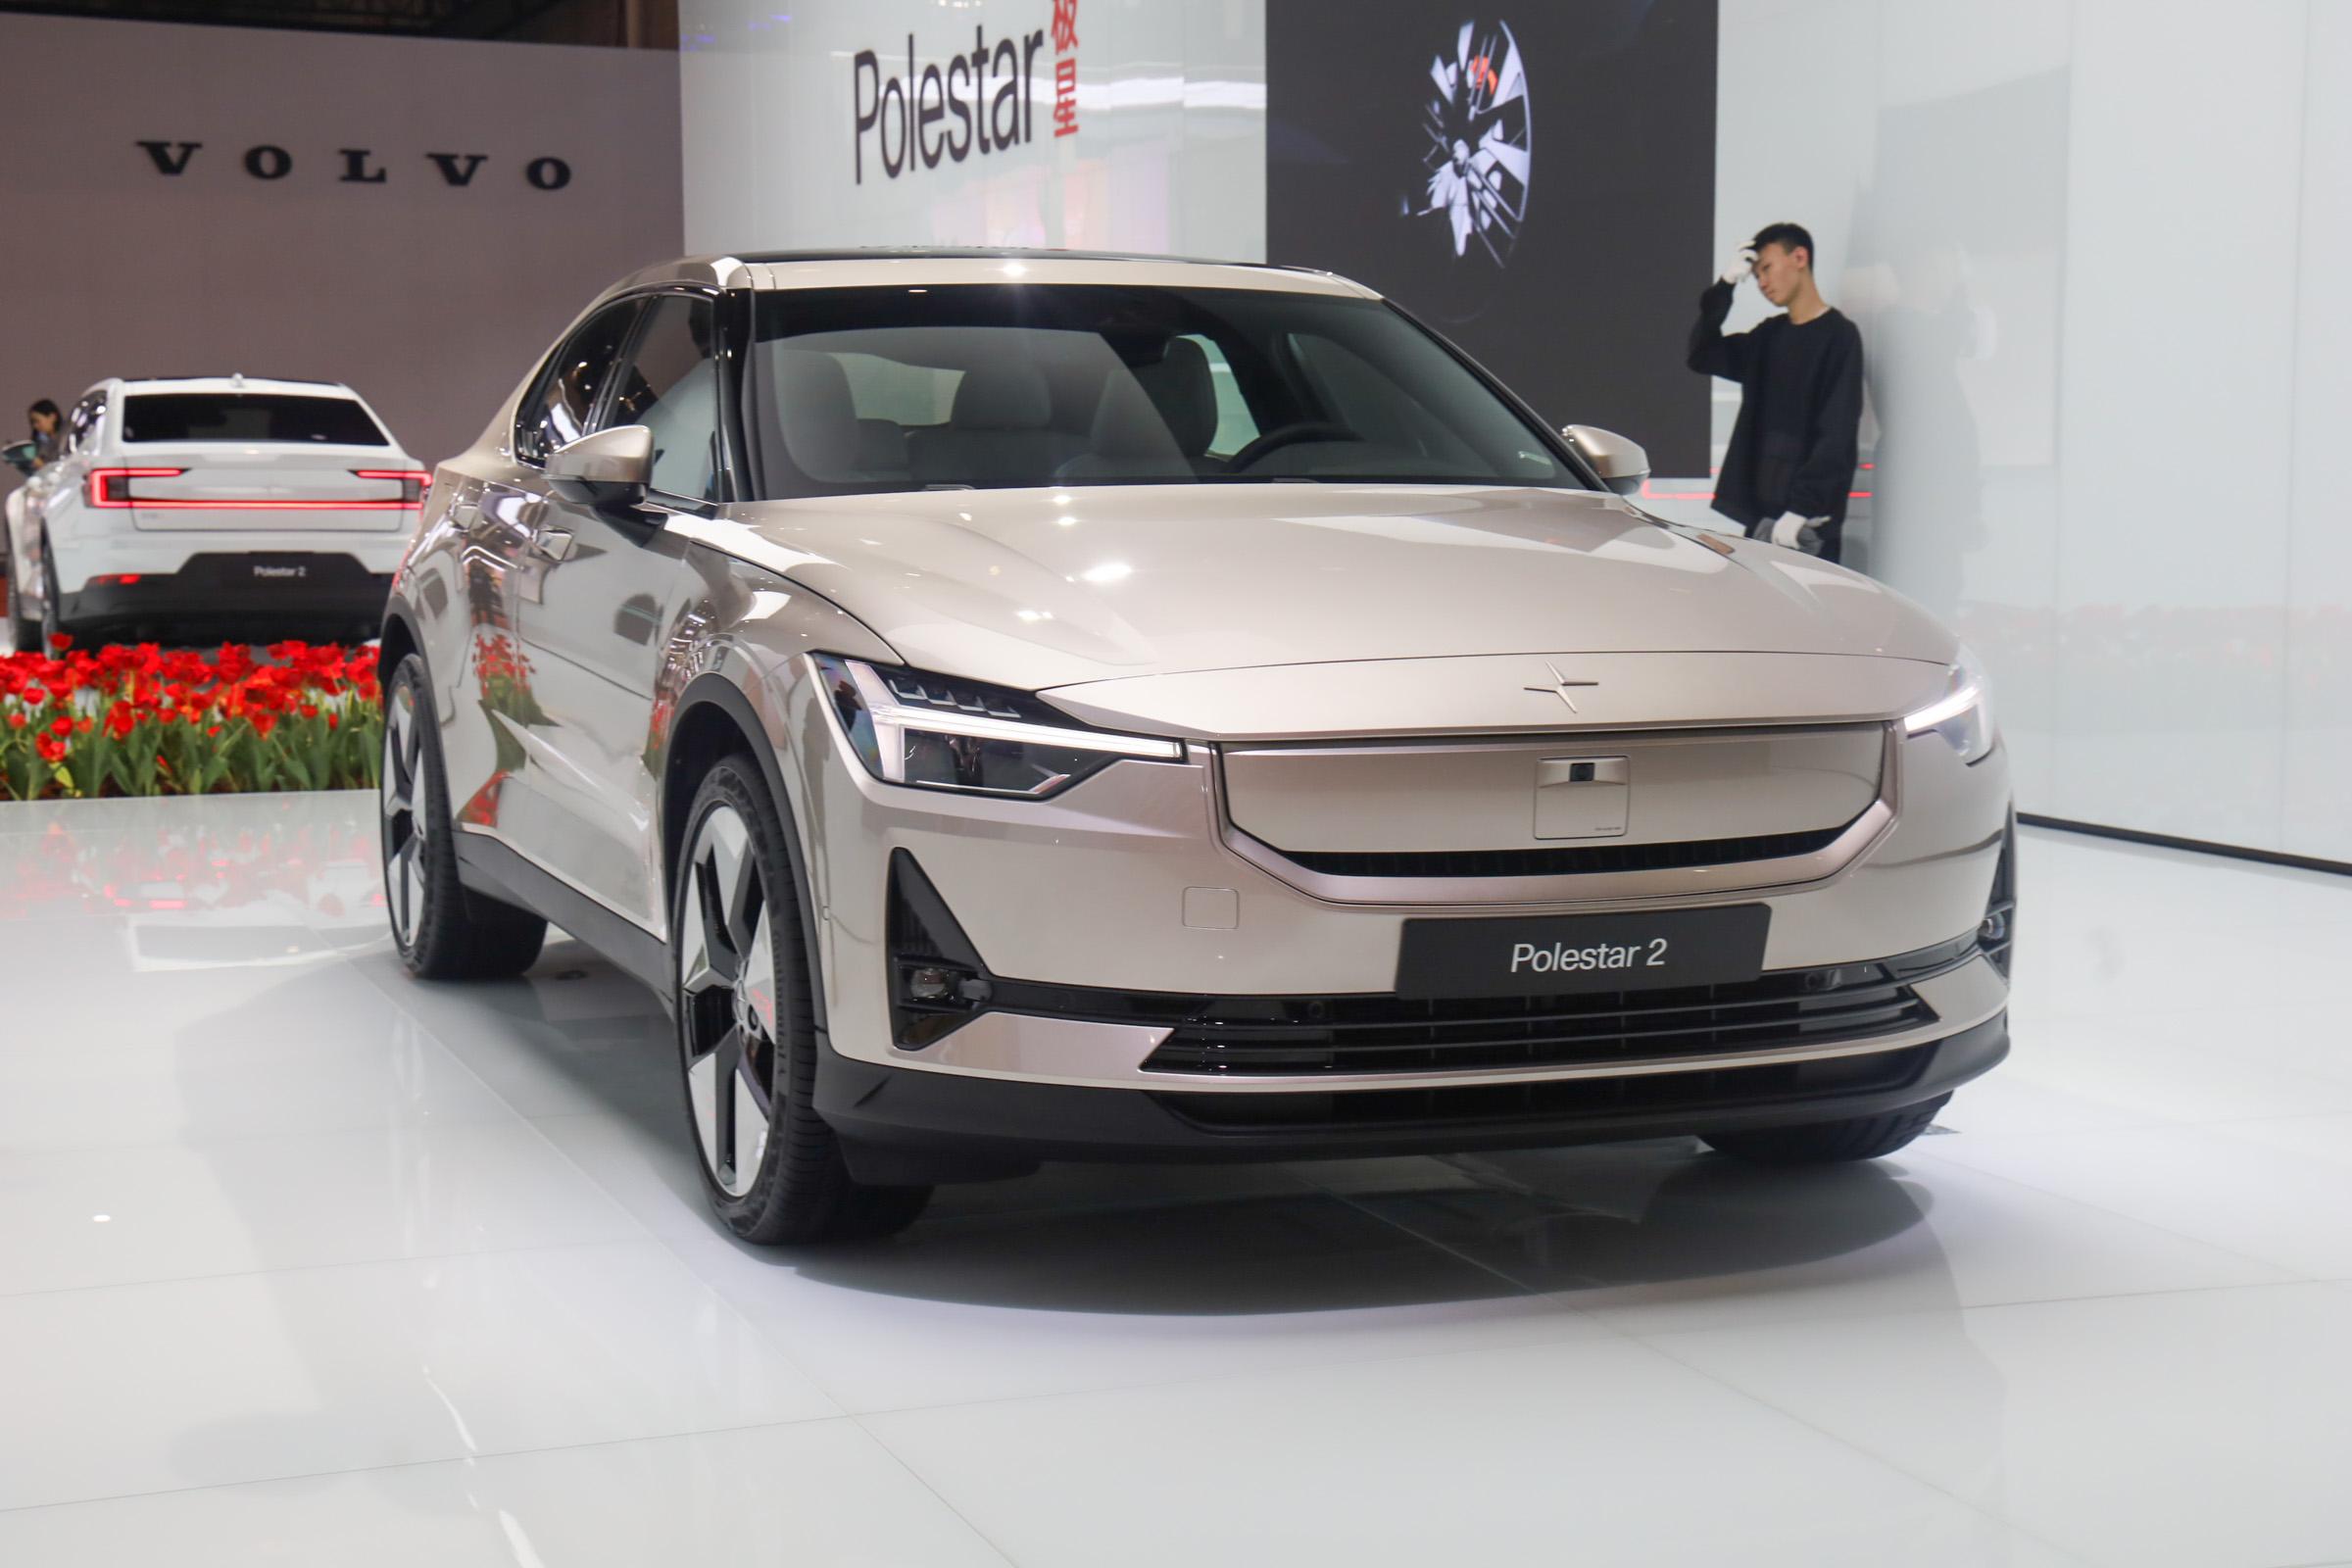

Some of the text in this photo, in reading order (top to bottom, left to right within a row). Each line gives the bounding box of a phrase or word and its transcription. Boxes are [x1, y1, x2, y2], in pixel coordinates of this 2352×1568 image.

[855, 24, 1044, 185] Polestar
[135, 140, 572, 191] VOLVO
[254, 565, 306, 576] Polestar 2
[1510, 938, 1668, 973] Polestar 2
